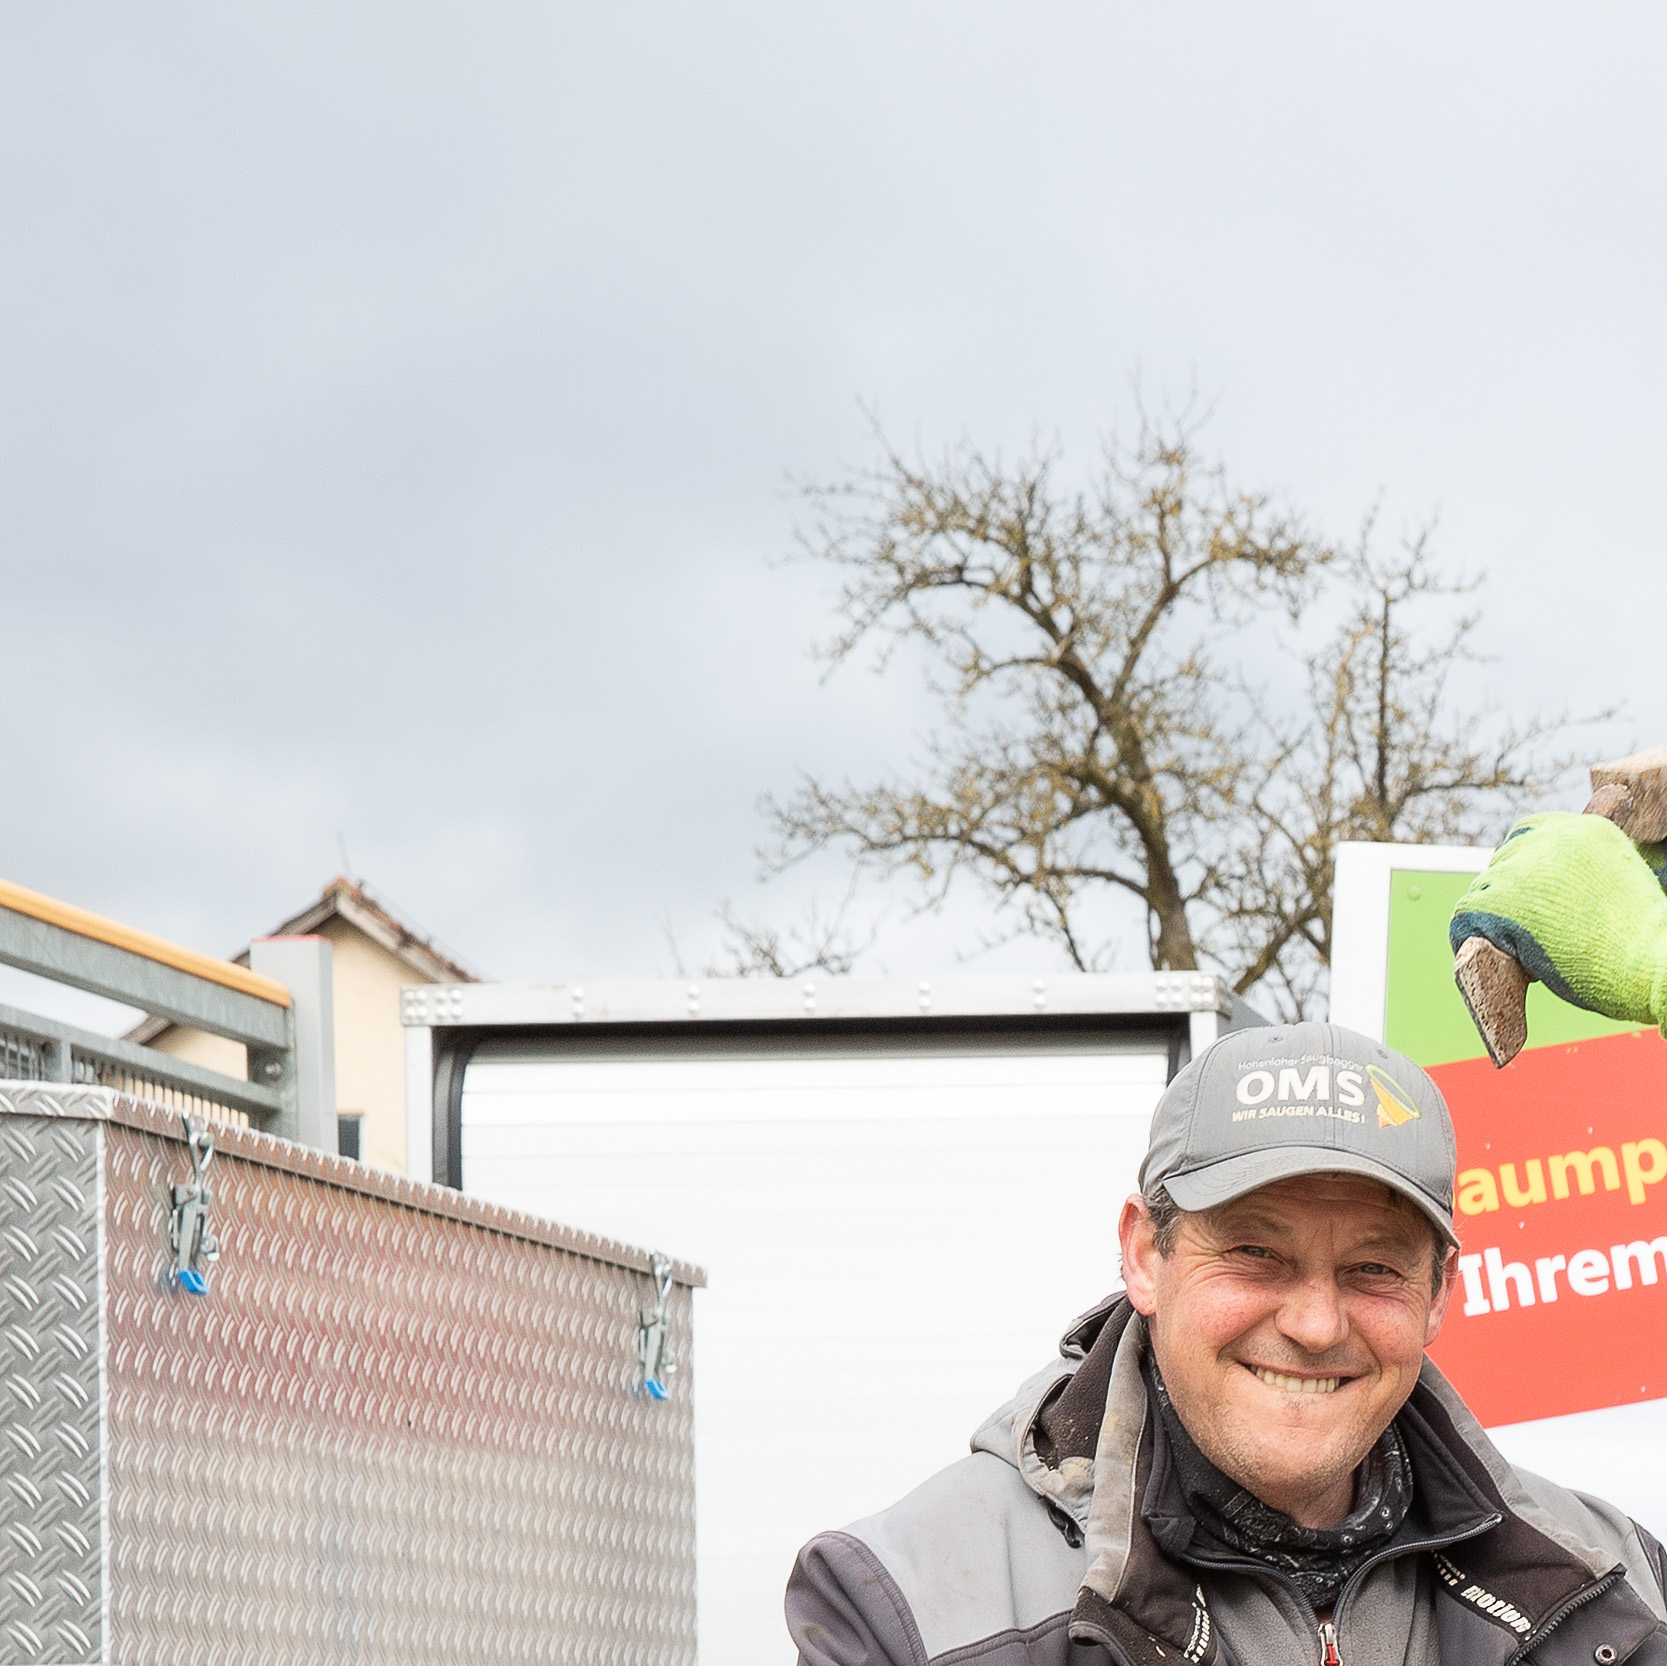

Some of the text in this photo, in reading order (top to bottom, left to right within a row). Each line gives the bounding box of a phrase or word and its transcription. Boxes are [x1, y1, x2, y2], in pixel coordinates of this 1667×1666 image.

[1235, 1065, 1366, 1107] OMS
[1231, 1105, 1366, 1124] WIR SAUGEN ALLES!
